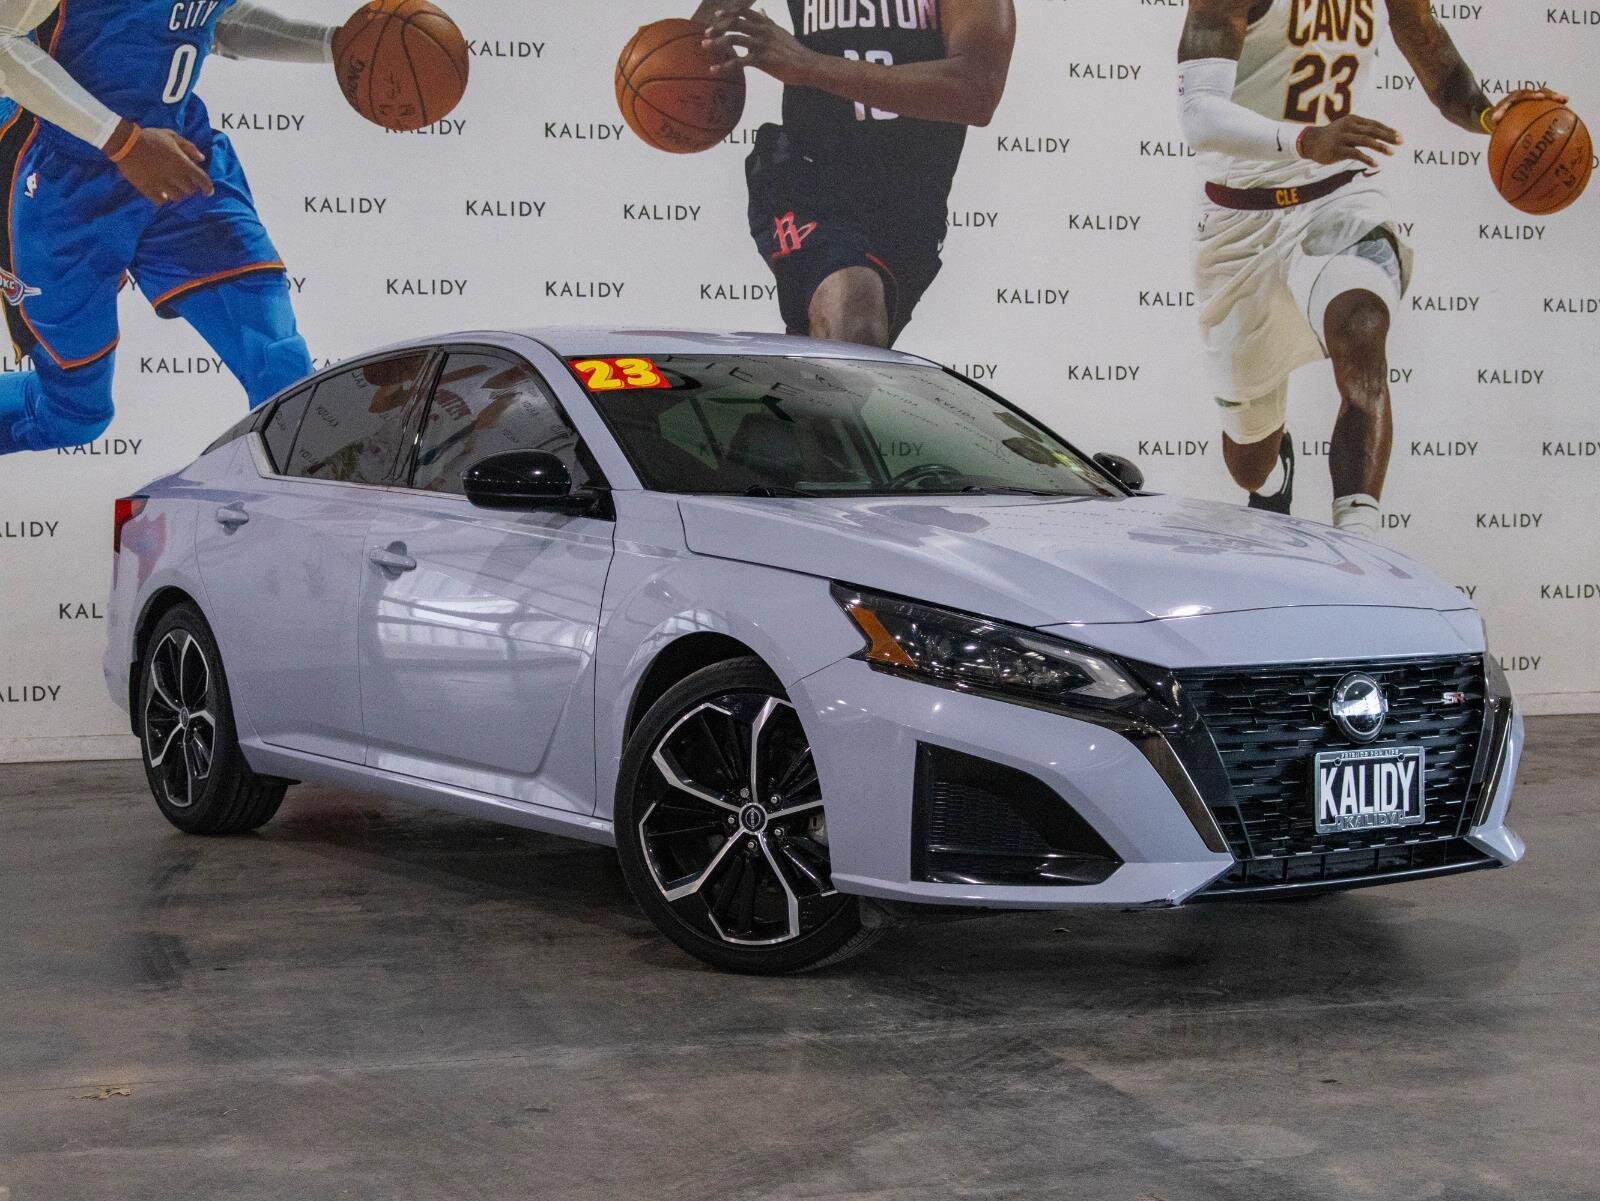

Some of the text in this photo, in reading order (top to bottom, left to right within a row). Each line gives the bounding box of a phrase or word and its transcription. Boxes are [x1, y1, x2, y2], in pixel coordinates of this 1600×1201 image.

[169, 0, 219, 31] CITY
[1430, 4, 1482, 20] ALIDY
[1547, 9, 1600, 25] KALID
[1288, 0, 1373, 48] CAVS
[467, 41, 544, 57] KALIDY
[162, 44, 197, 104] 0
[1070, 63, 1141, 80] KALIDY
[1284, 53, 1360, 124] 23
[1376, 75, 1415, 90] IDY
[221, 113, 304, 130] KALIDY
[544, 122, 624, 140] KALIDY
[998, 136, 1070, 153] KALIDY
[1414, 150, 1481, 165] KALIDY
[305, 197, 386, 213] KALIDY
[1275, 188, 1298, 206] CLE
[466, 200, 545, 217] KALIDY
[624, 204, 701, 221] KALIDY
[947, 212, 998, 228] LIDY
[1069, 215, 1140, 230] KALIDY
[1480, 225, 1545, 240] KALIDY
[387, 279, 467, 295] KALIDY
[546, 281, 624, 297] KALIDY
[700, 285, 776, 300] KALIDY
[997, 289, 1069, 304] KALIDY
[1140, 291, 1194, 306] KALID
[1413, 296, 1479, 311] KALIDY
[1544, 298, 1597, 313] KALID
[140, 357, 223, 373] KALIDY
[953, 364, 997, 379] IDY
[1069, 366, 1139, 380] KALIDY
[574, 358, 661, 390] 23
[1478, 369, 1544, 384] KALIDY
[881, 442, 924, 457] LIDY
[1139, 441, 1208, 455] KALIDY
[1302, 441, 1331, 456] LID
[1411, 442, 1478, 456] KALIDY
[1543, 442, 1600, 456] KALID
[1381, 514, 1411, 528] IDY
[1477, 514, 1542, 528] KALIDY
[0, 521, 59, 538] LIDY
[59, 603, 103, 619] KAL
[1500, 656, 1541, 671] LIDY
[1320, 761, 1416, 820] KALIDY
